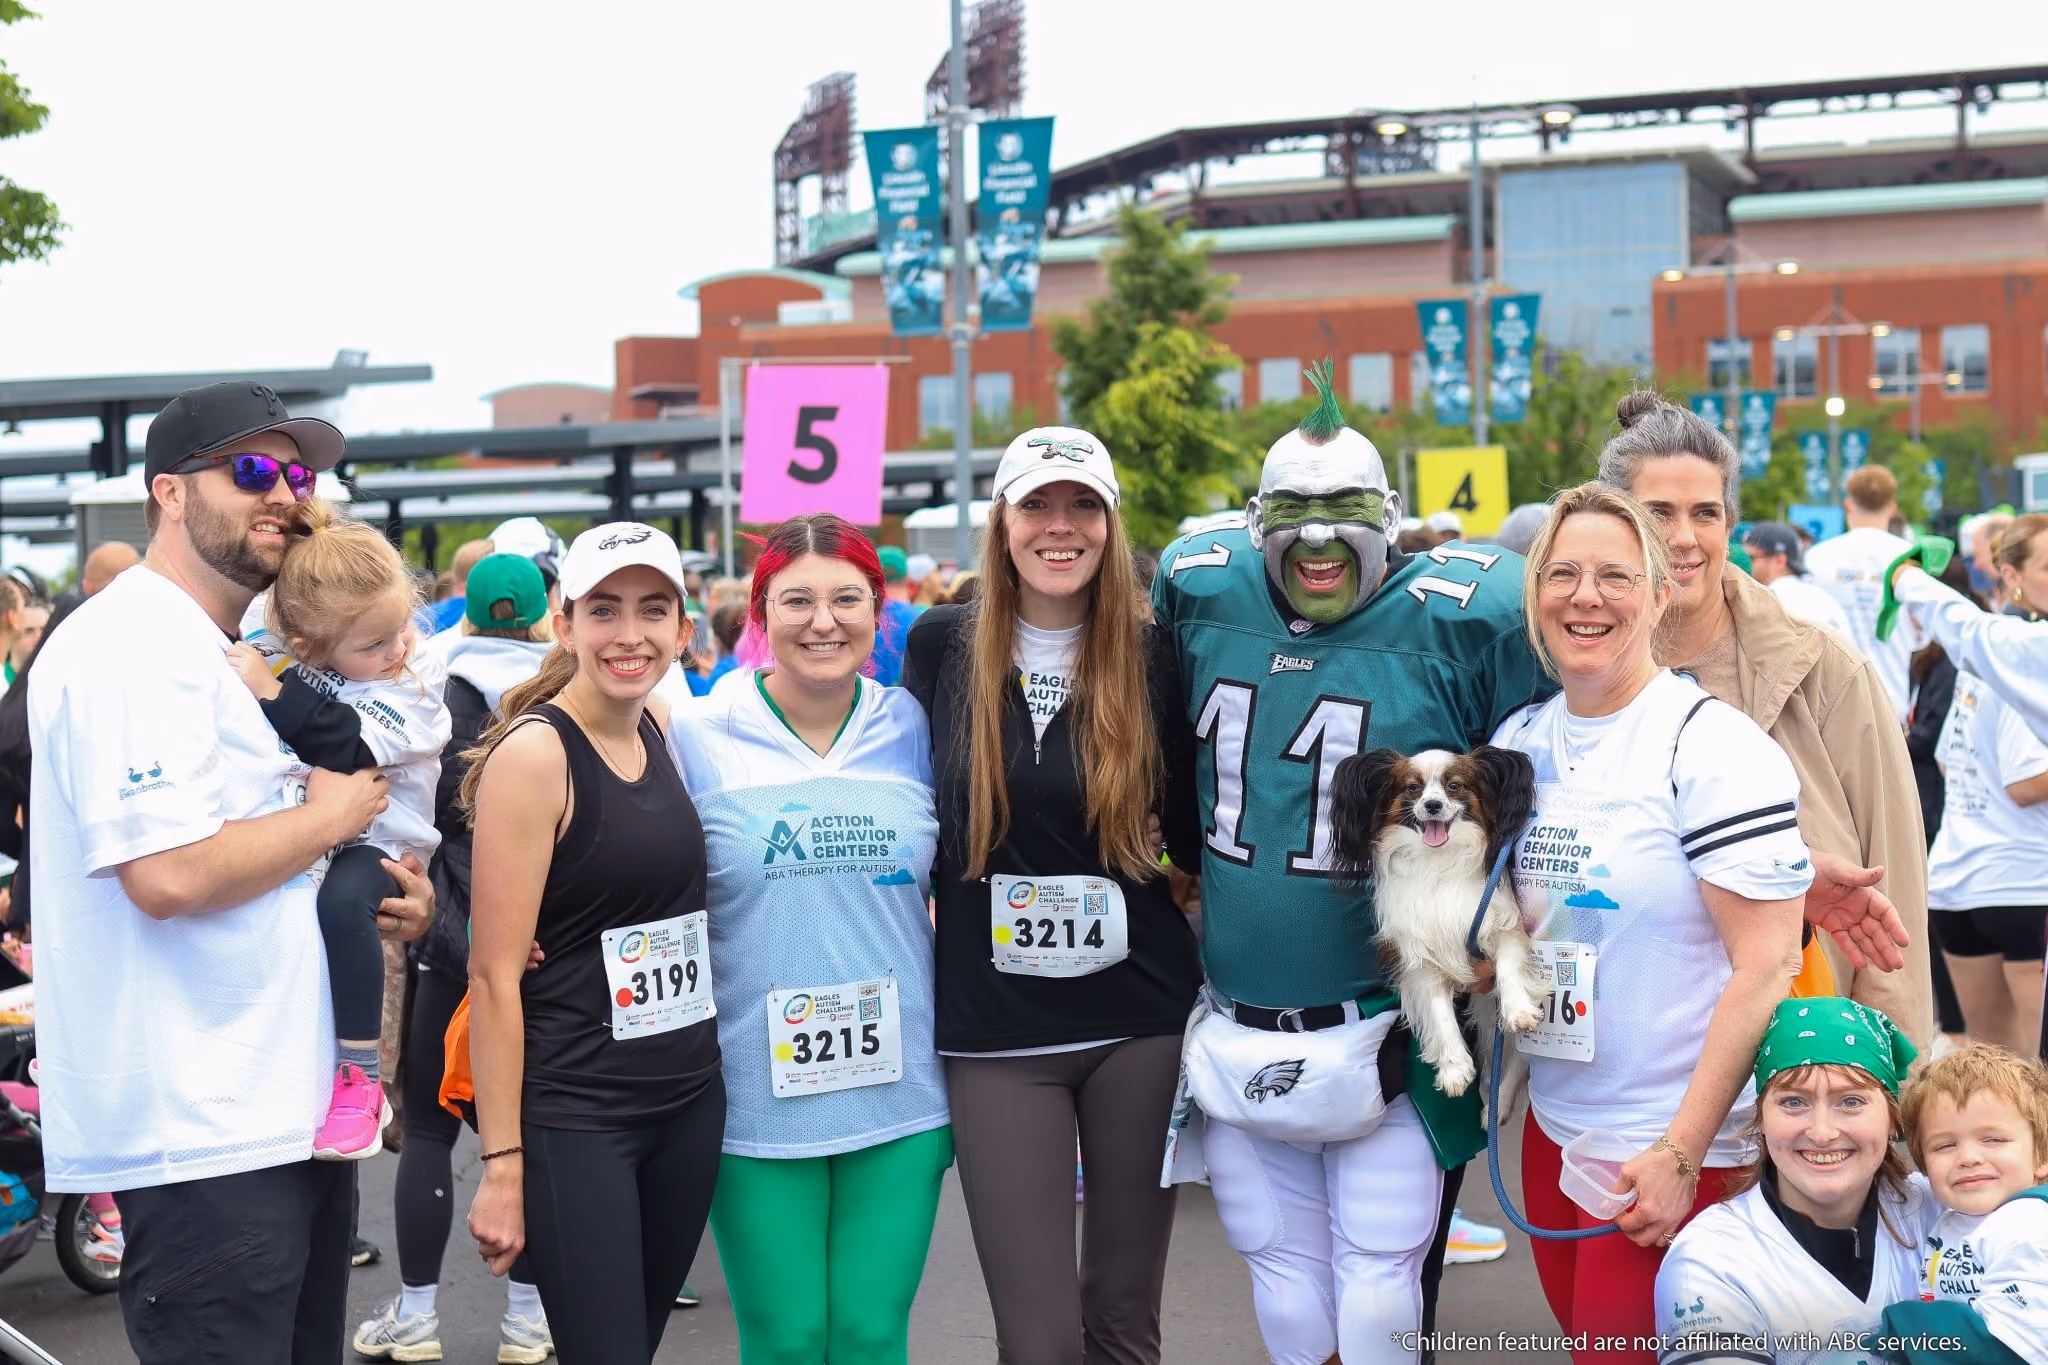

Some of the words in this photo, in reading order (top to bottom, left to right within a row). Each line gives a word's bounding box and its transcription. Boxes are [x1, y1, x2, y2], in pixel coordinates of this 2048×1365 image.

[787, 406, 839, 484] 5
[1449, 471, 1479, 513] 4
[1027, 688, 1066, 702] AUTI
[355, 700, 391, 729] EAGLES
[1196, 677, 1373, 882] 11
[811, 815, 875, 829] ACTION
[811, 829, 897, 844] BEHAVIOR
[1528, 826, 1578, 841] ACTION
[814, 844, 889, 859] CENTERS
[1523, 841, 1592, 859] BEHAVIOR
[765, 872, 785, 881] ABA
[788, 866, 834, 878] THERAPY
[837, 864, 857, 874] FOR
[859, 864, 897, 873] AUTISM
[1520, 857, 1579, 874] CENTERS
[1515, 877, 1534, 888] RAPY
[1535, 879, 1550, 889] FOR
[1551, 883, 1586, 893] AUTISM
[648, 929, 669, 938] EAGLES
[649, 935, 670, 945] AUTISM
[1014, 917, 1104, 948] 3214
[649, 940, 681, 951] CHALLENGE
[631, 959, 698, 1006] 3199
[814, 993, 840, 1002] EAGLES
[815, 1000, 841, 1008] AUTISM
[815, 1004, 855, 1015] CHALLENGE
[1540, 990, 1576, 1025] 16
[792, 1023, 880, 1064] 3215
[1940, 1280, 1981, 1295] CHALL
